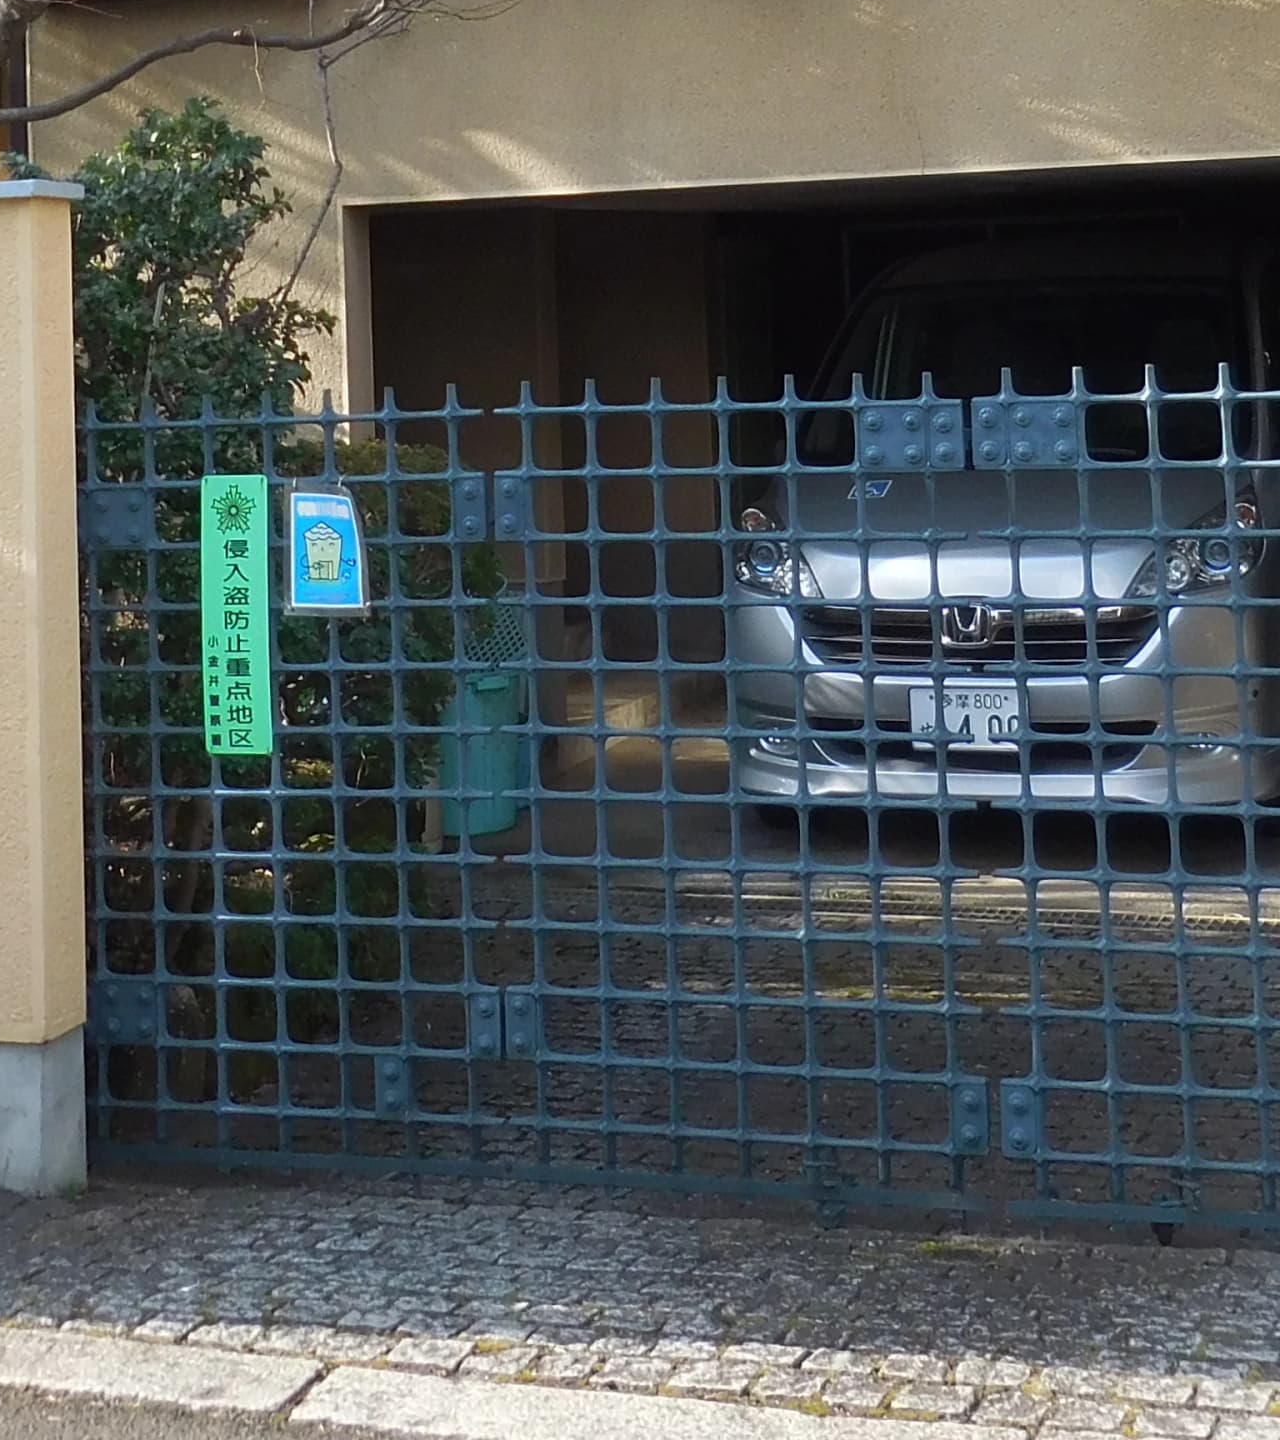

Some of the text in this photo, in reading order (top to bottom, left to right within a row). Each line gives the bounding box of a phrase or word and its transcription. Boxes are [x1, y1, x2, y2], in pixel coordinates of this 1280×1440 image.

[207, 635, 222, 747] 小金井
[223, 539, 255, 748] 侵入盗防止重点地区
[973, 693, 1002, 710] 800
